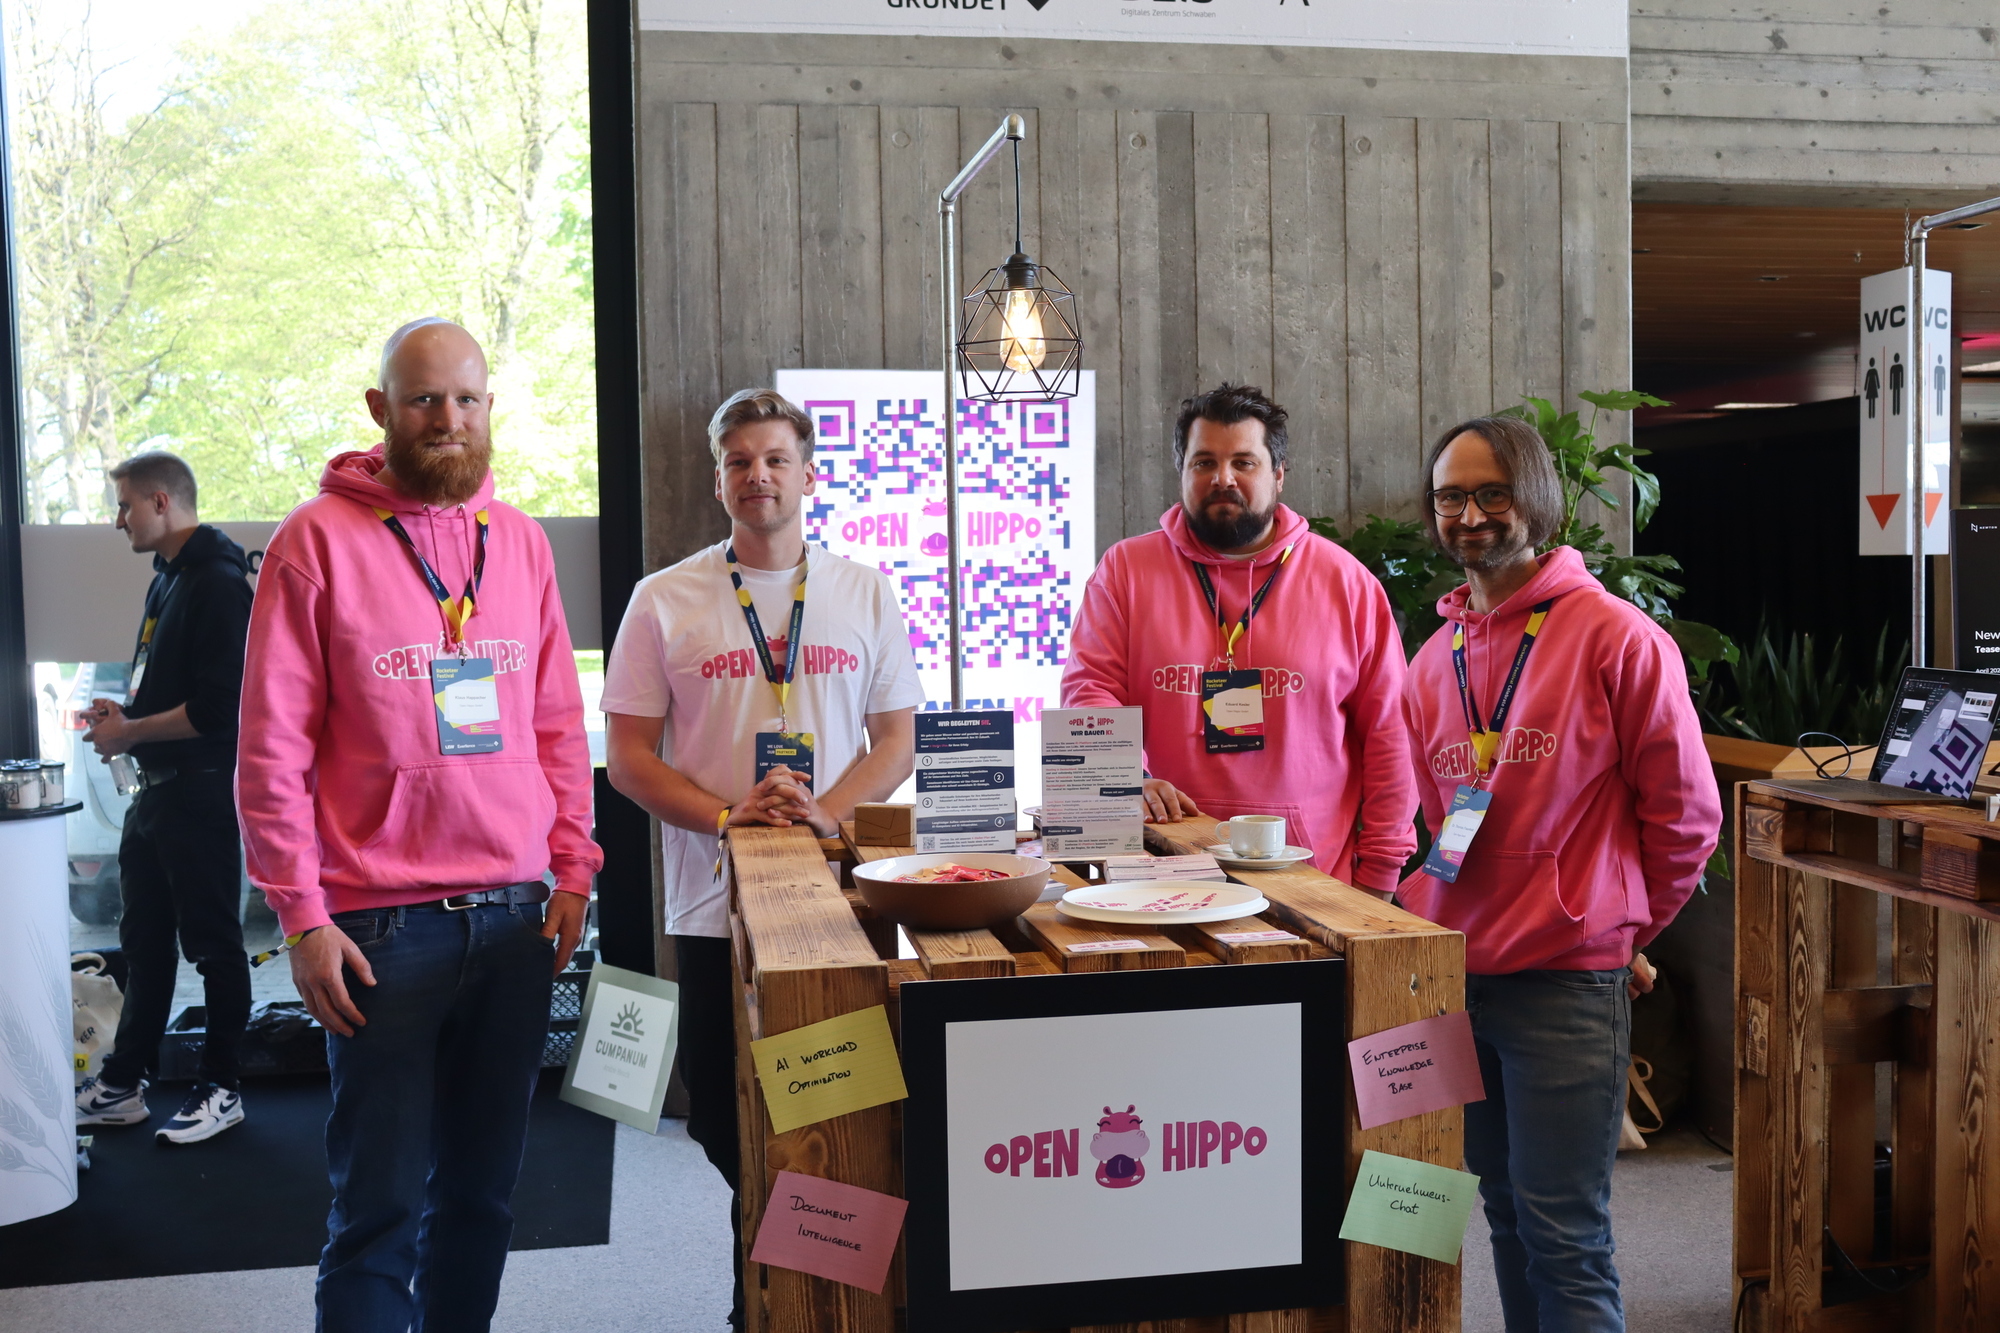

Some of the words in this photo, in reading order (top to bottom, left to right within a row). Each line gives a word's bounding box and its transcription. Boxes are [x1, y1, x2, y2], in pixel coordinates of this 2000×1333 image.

[1121, 8, 1150, 16] Digitales
[1152, 9, 1180, 17] Zentrum
[1182, 10, 1216, 18] Schwaben
[1864, 305, 1906, 333] WC
[842, 512, 908, 547] OPEN
[968, 511, 1042, 547] HIPPO
[373, 644, 434, 680] OPEN
[701, 648, 756, 680] OPEN
[803, 645, 859, 675] HIPPO
[1153, 664, 1204, 696] OPEN
[1069, 718, 1084, 726] OPEN
[1097, 717, 1114, 726] HIPPO
[1433, 741, 1471, 778] OPEN
[595, 1039, 648, 1069] CUMPANUM
[776, 1058, 789, 1073] AI
[800, 1041, 858, 1065] WORKLOAD
[984, 1128, 1079, 1178] OPEN
[1163, 1120, 1268, 1172] HIPPO
[1368, 1173, 1451, 1203] Unternehmens-
[1390, 1200, 1420, 1215] Chat
